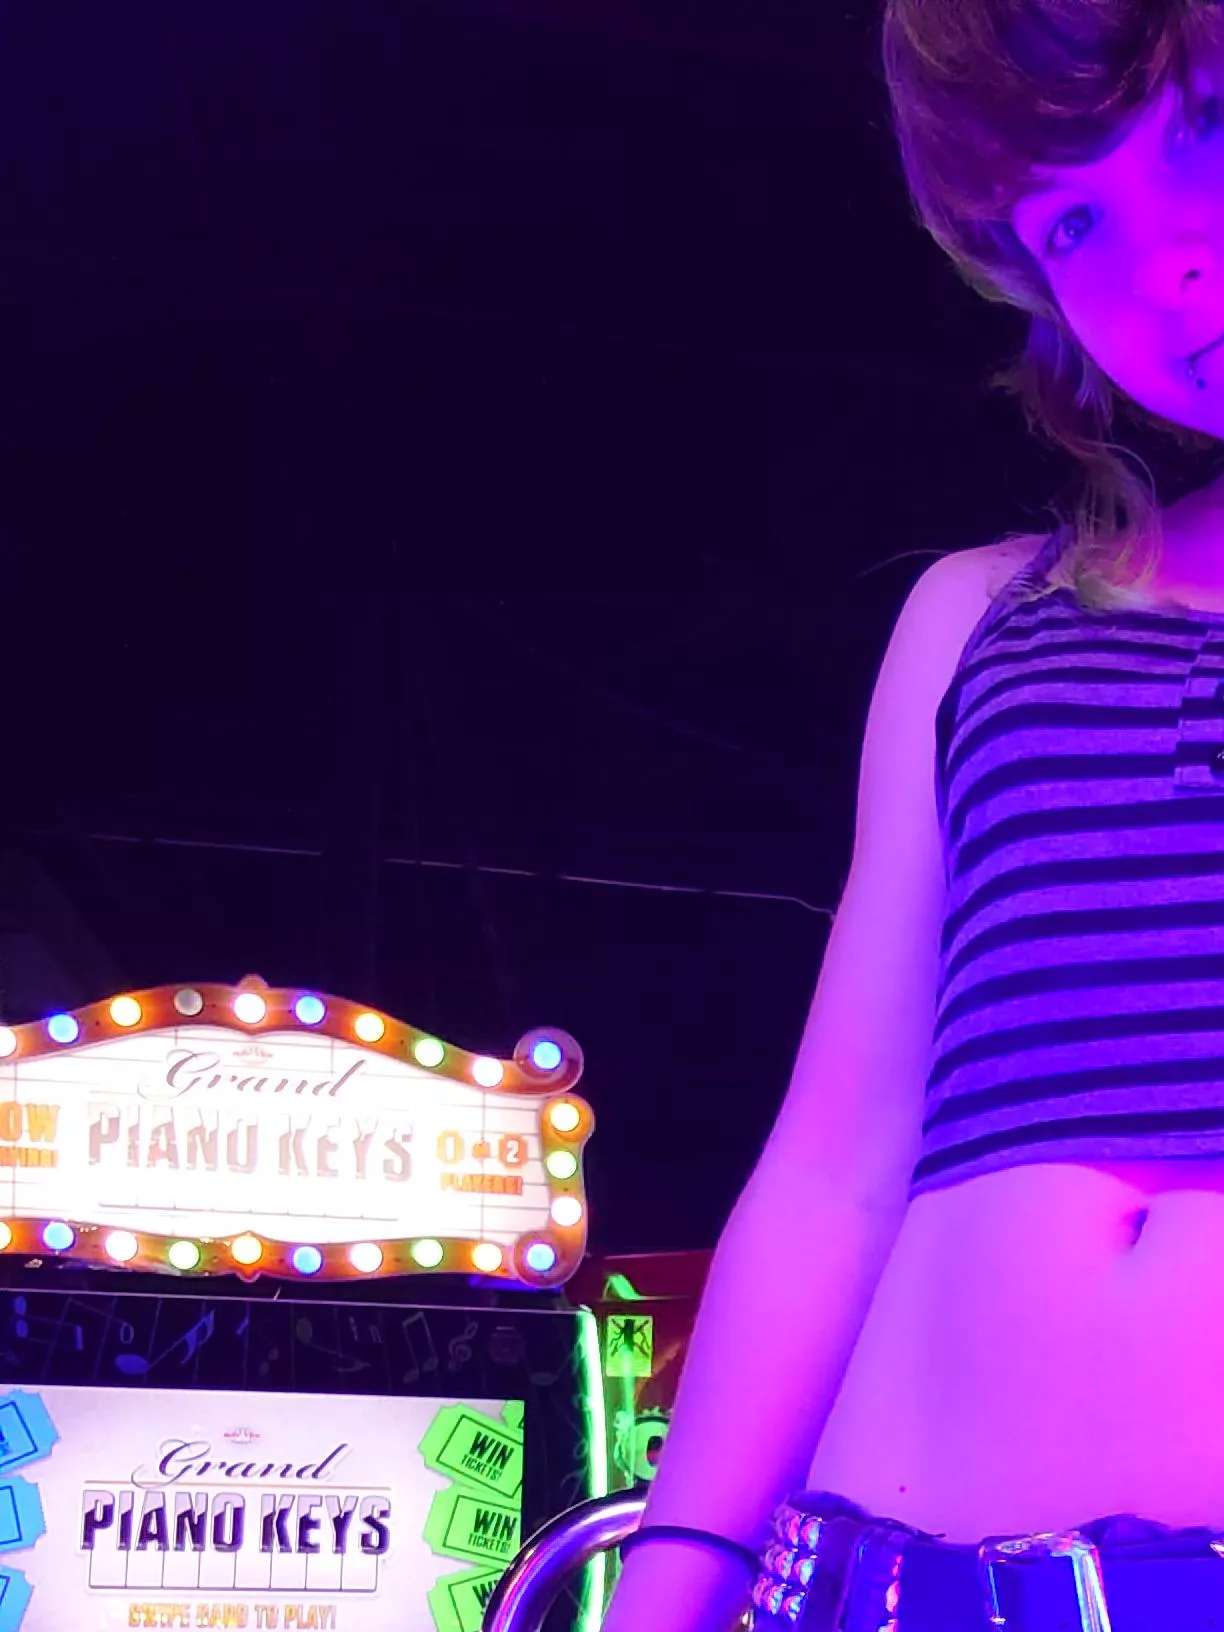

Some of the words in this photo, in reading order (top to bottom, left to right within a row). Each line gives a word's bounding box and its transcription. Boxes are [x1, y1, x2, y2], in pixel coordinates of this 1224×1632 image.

[137, 1048, 366, 1100] Grand
[88, 1101, 259, 1174] PIANO
[277, 1111, 414, 1182] KEYS
[131, 1439, 348, 1489] Grand
[460, 1453, 502, 1482] TICKETS!
[469, 1430, 515, 1470] WIN
[80, 1489, 246, 1553] PIANO
[259, 1494, 392, 1555] KEYS
[473, 1508, 518, 1542] WIN
[254, 1604, 279, 1629] TO
[284, 1604, 337, 1630] PLAY!
